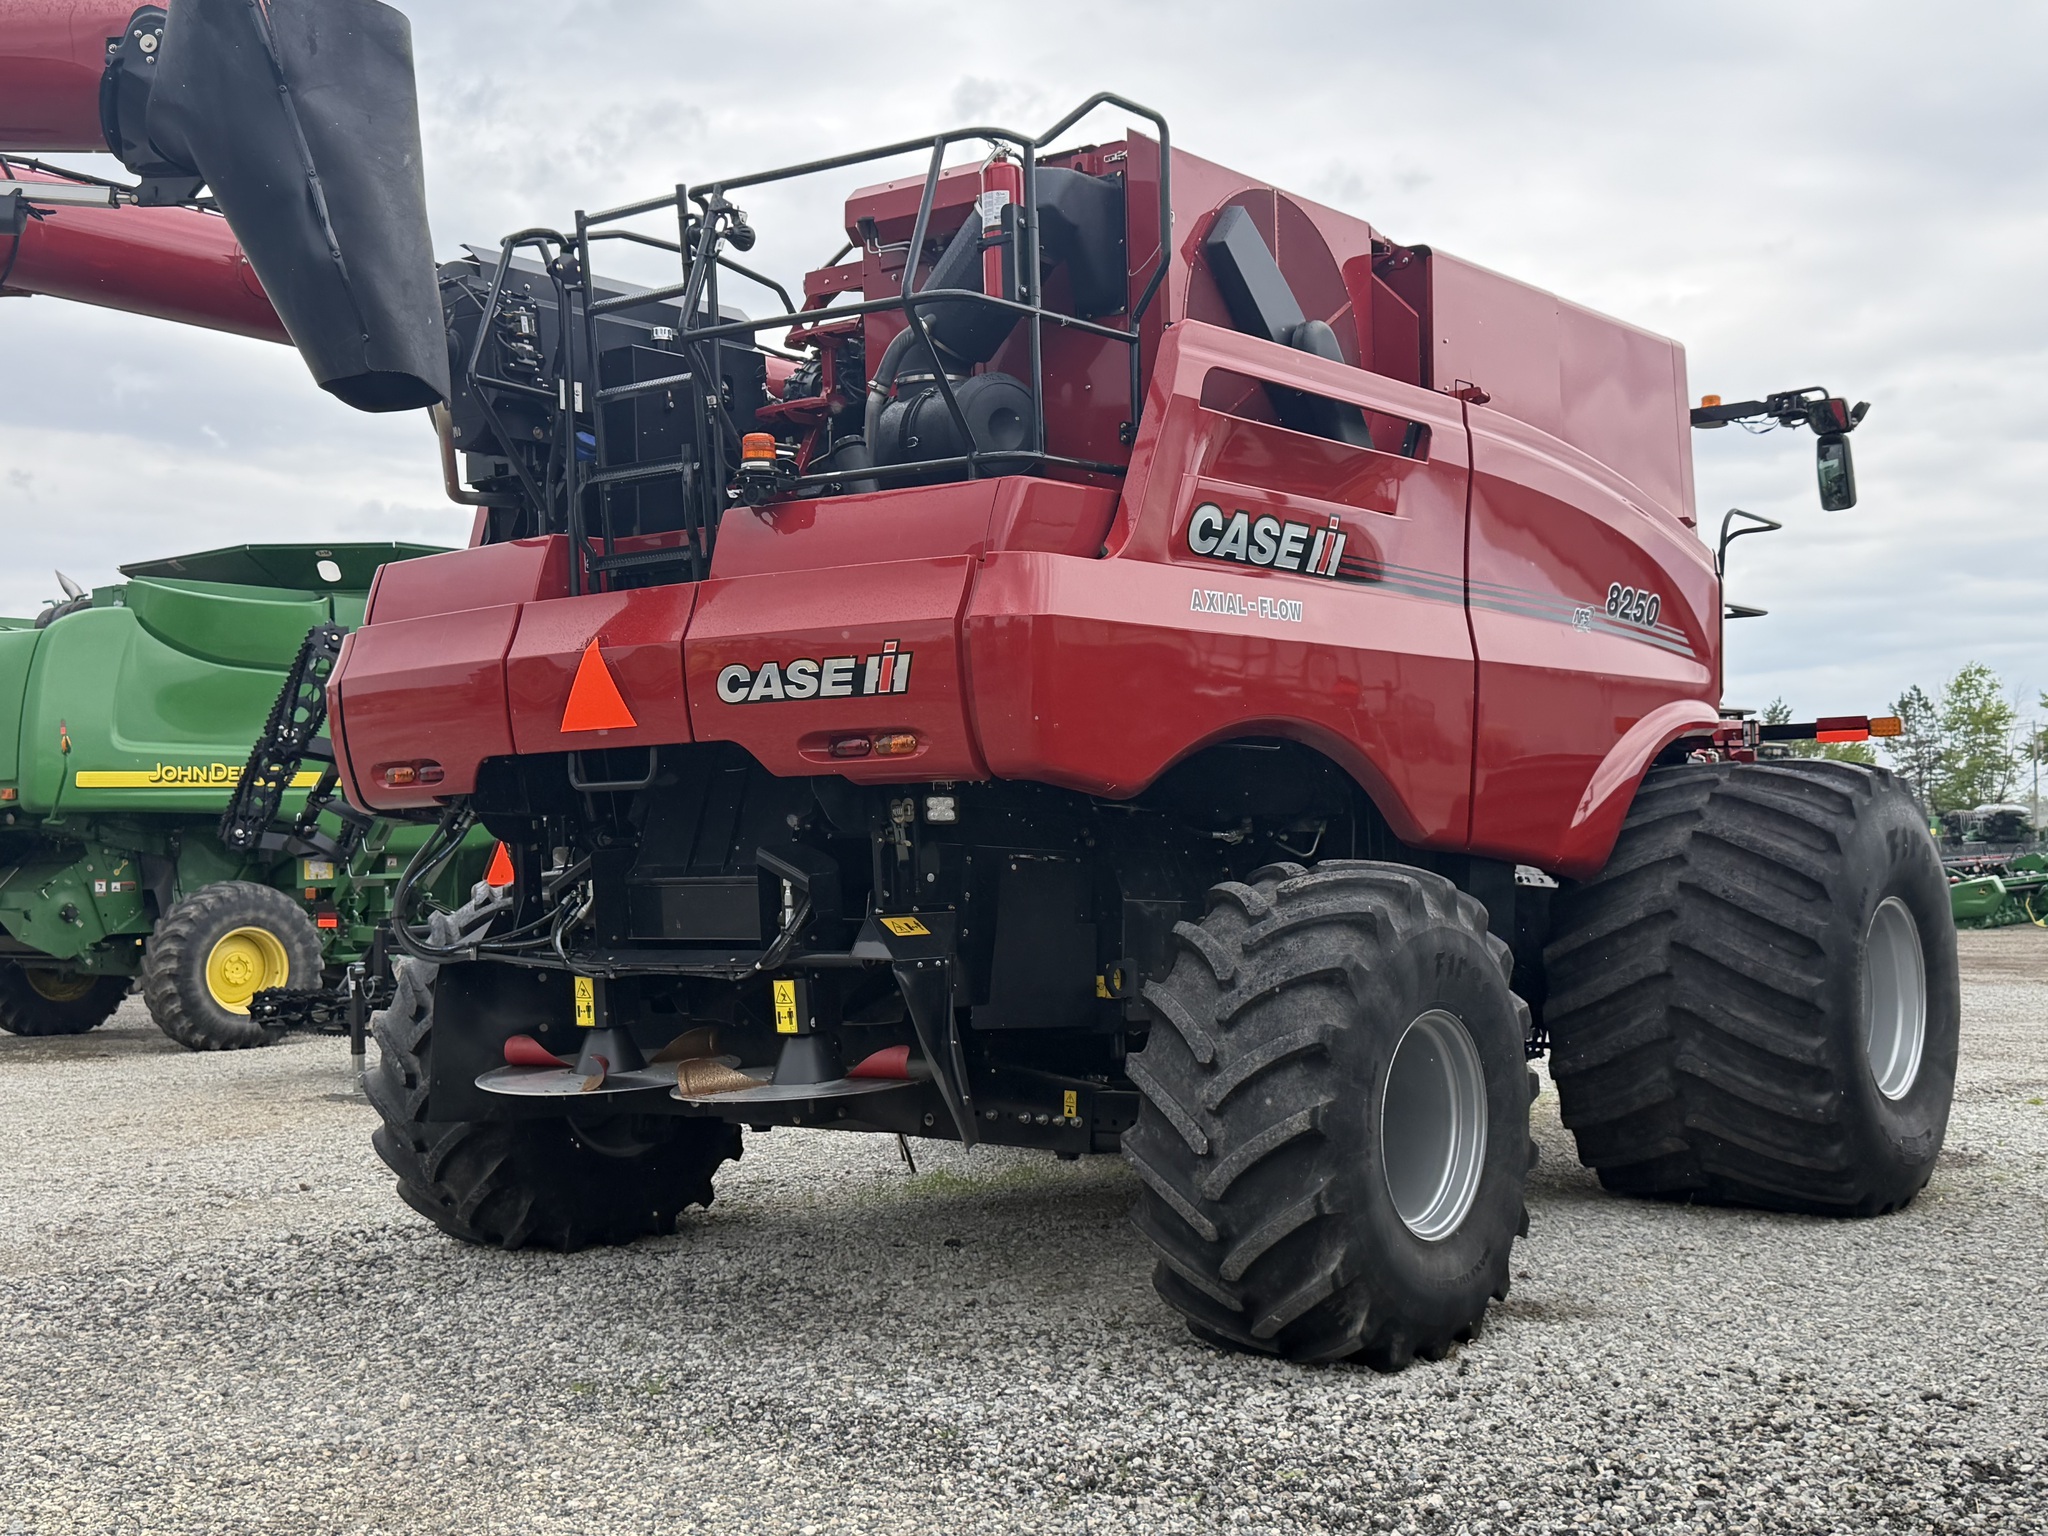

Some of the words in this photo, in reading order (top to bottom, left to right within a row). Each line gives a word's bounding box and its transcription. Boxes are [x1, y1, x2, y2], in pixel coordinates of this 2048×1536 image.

[1188, 503, 1310, 570] CASE
[1190, 588, 1303, 622] AXIAL-FLOW
[1605, 581, 1661, 628] 8250
[716, 657, 857, 703] CASE
[149, 762, 208, 782] JOHN
